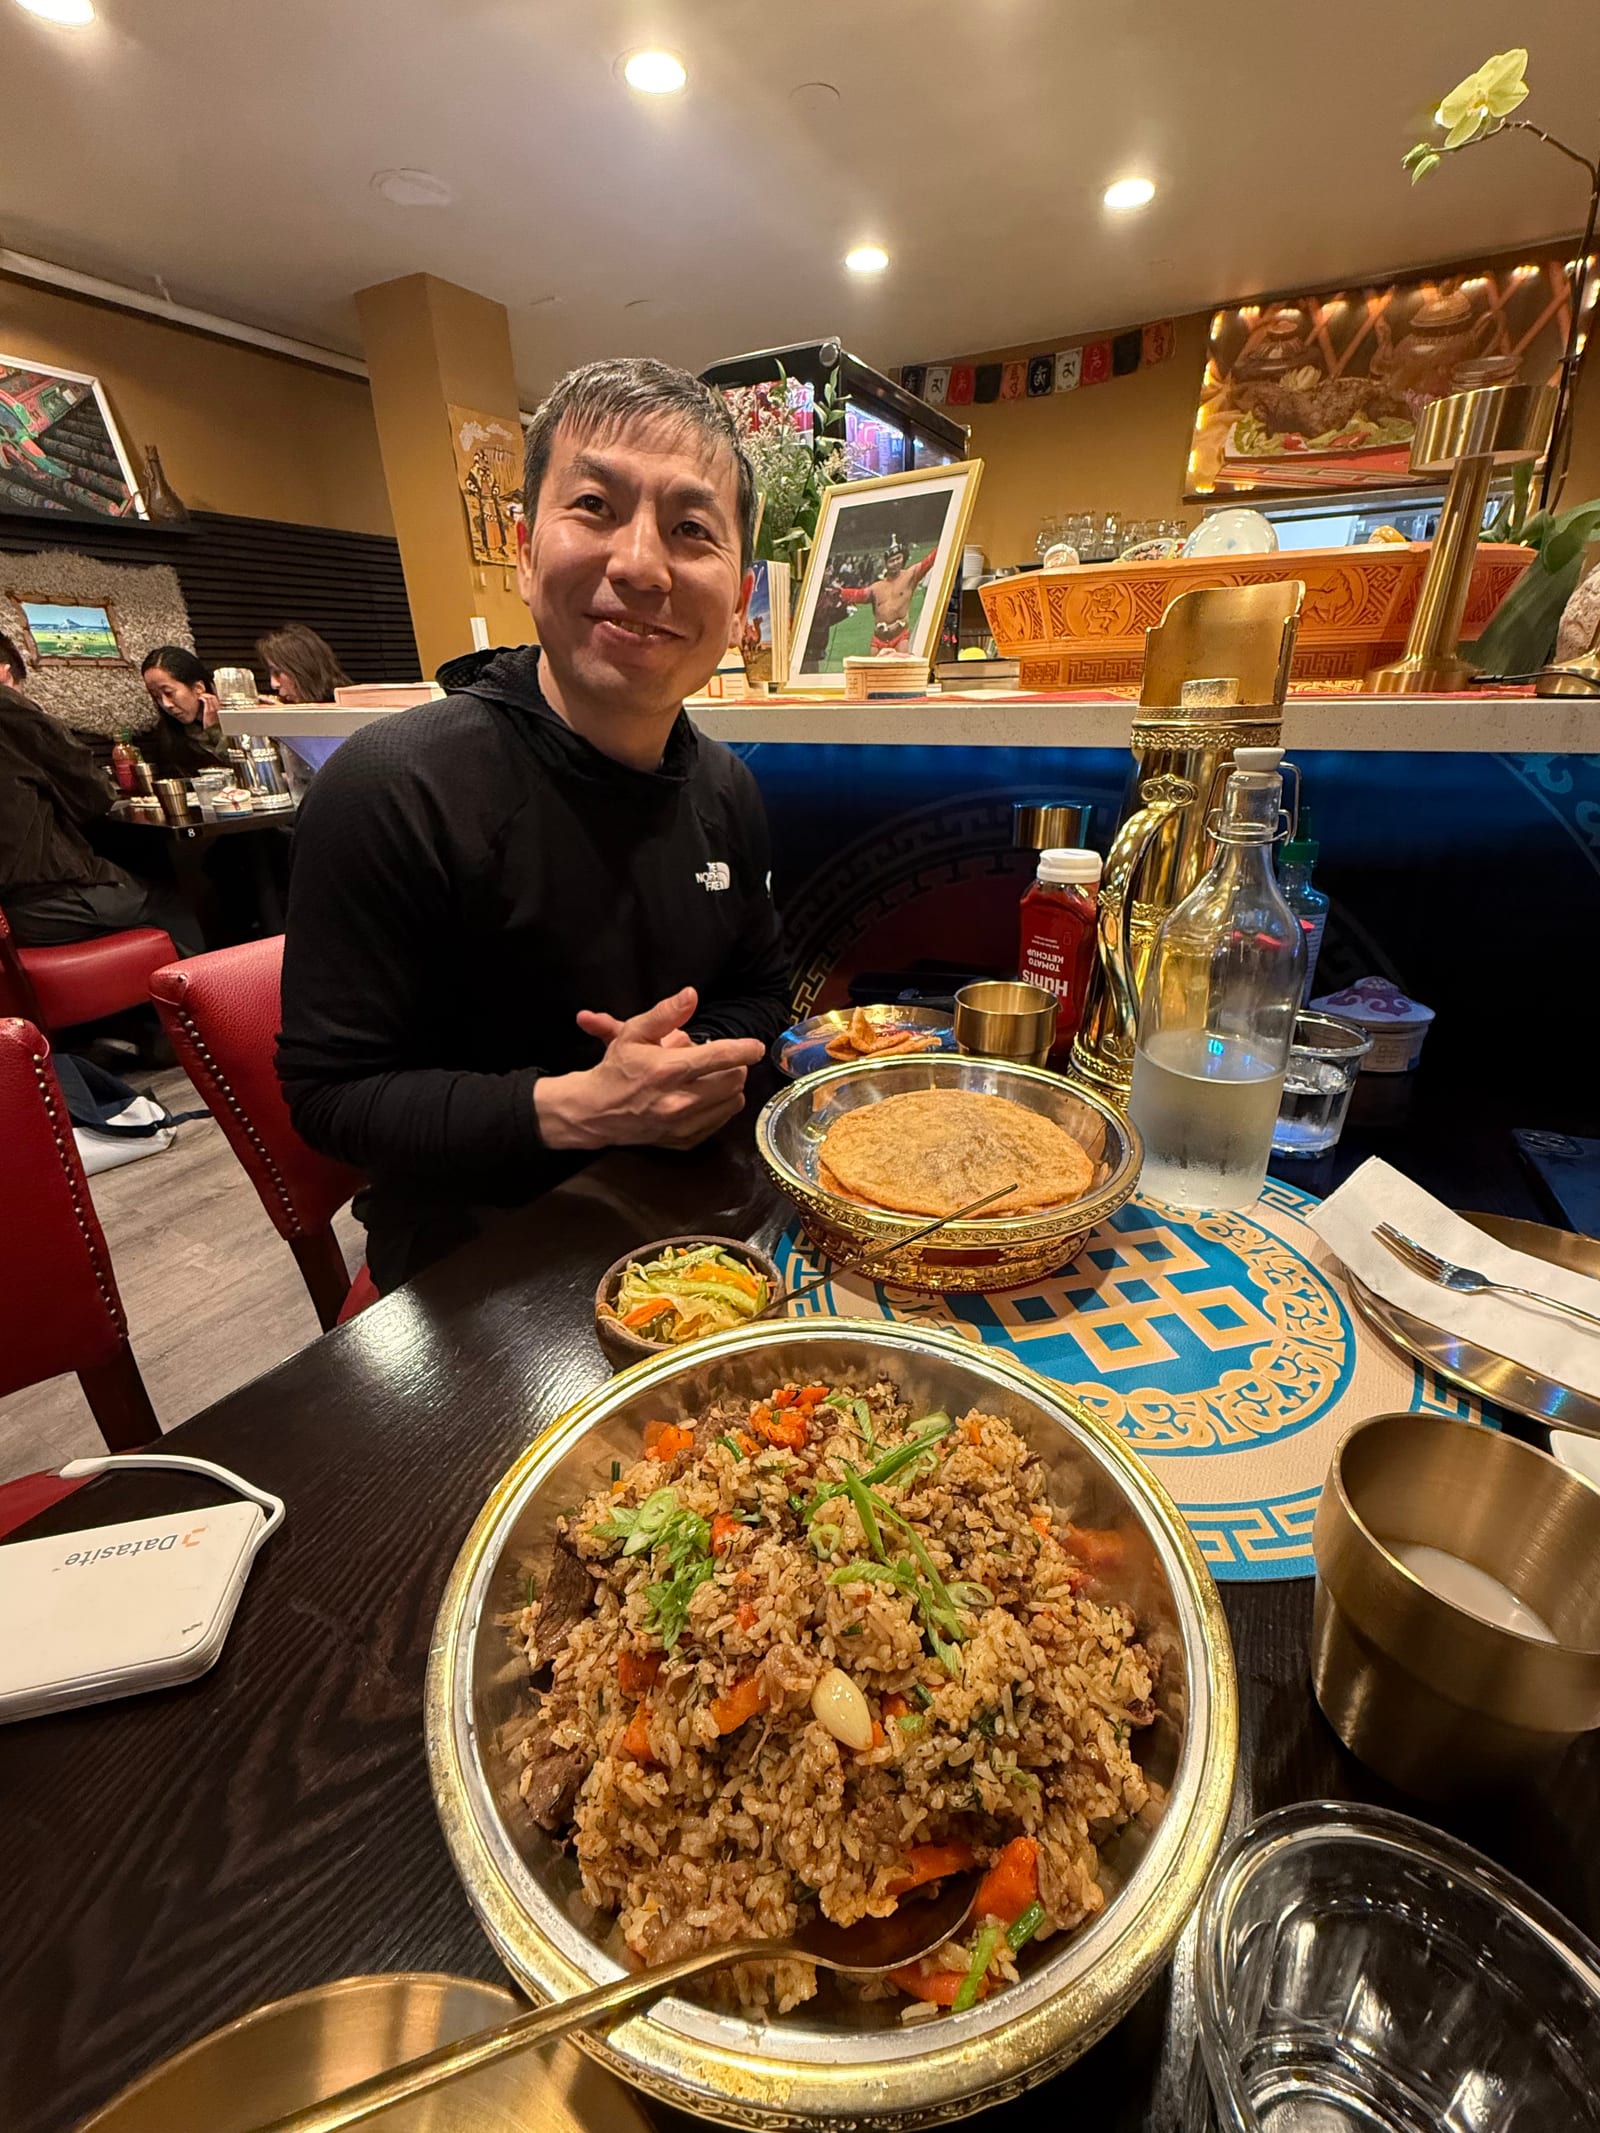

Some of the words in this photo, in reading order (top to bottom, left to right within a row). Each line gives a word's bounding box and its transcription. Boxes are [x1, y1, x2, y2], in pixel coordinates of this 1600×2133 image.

[187, 827, 196, 838] 8
[695, 872, 719, 883] NORTH
[1026, 948, 1064, 965] KETCHUP
[1027, 957, 1061, 973] TOMATO
[64, 1534, 179, 1567] Datasite
